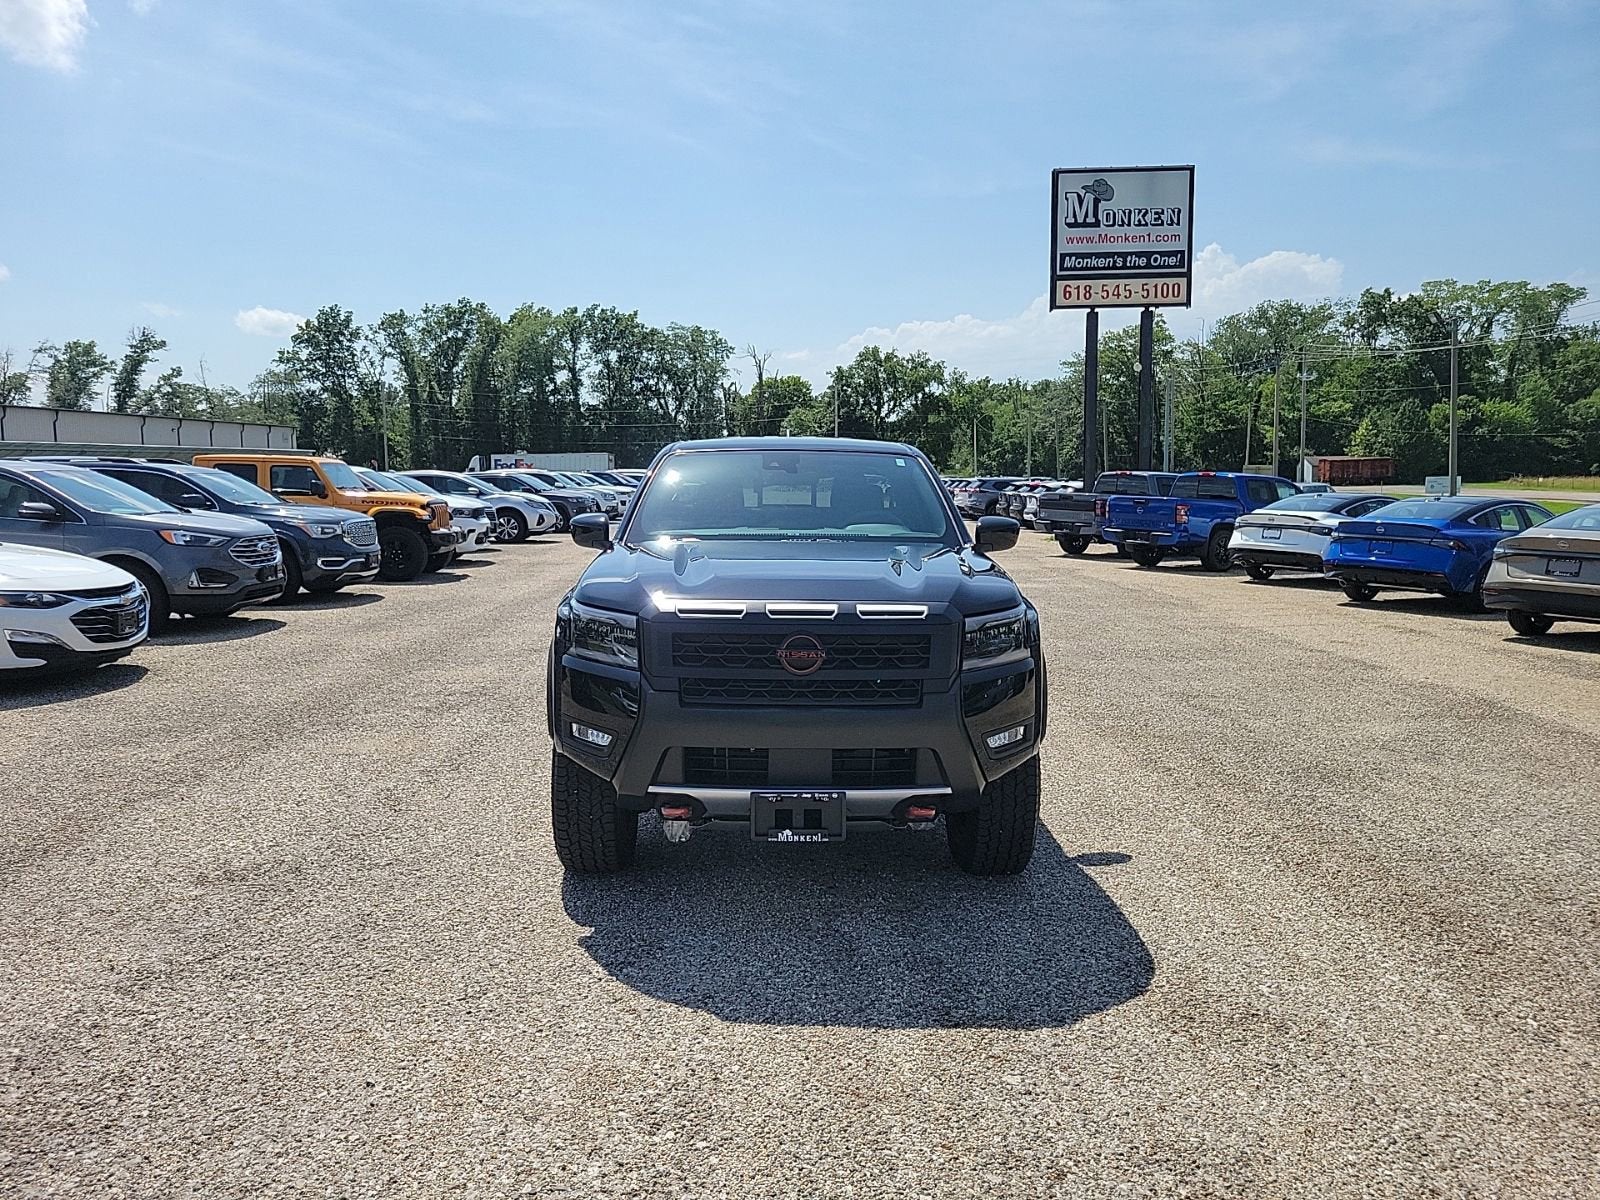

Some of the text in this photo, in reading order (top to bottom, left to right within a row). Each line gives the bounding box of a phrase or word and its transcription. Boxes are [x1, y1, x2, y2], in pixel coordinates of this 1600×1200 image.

[1065, 191, 1181, 228] MONKEN
[1066, 232, 1181, 245] www.Monken1.com
[1064, 254, 1181, 268] Monken's the One!
[1062, 282, 1181, 301] 618-545-5100
[494, 459, 534, 469] FedEx
[777, 649, 826, 658] NISSAN
